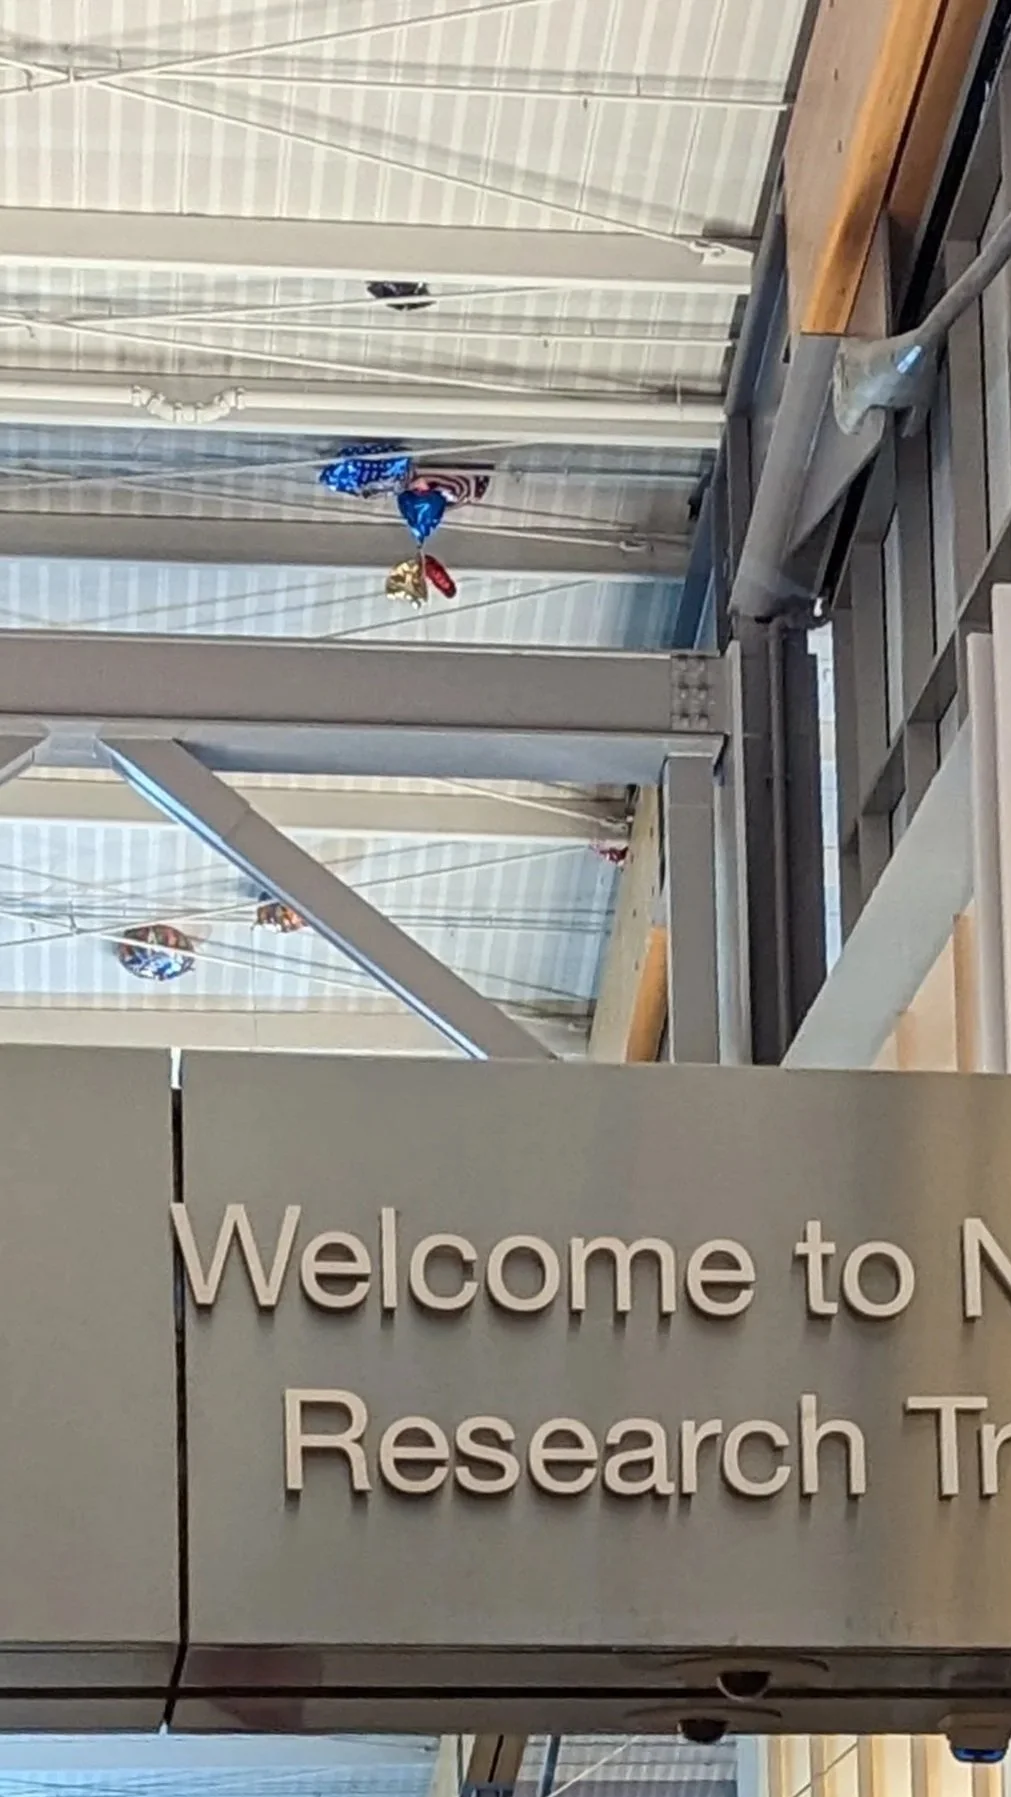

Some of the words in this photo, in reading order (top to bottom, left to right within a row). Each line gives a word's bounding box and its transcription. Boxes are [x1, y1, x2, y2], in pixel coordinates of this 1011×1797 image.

[170, 1202, 757, 1317] Welcome
[795, 1219, 916, 1318] to
[284, 1387, 867, 1496] Research
